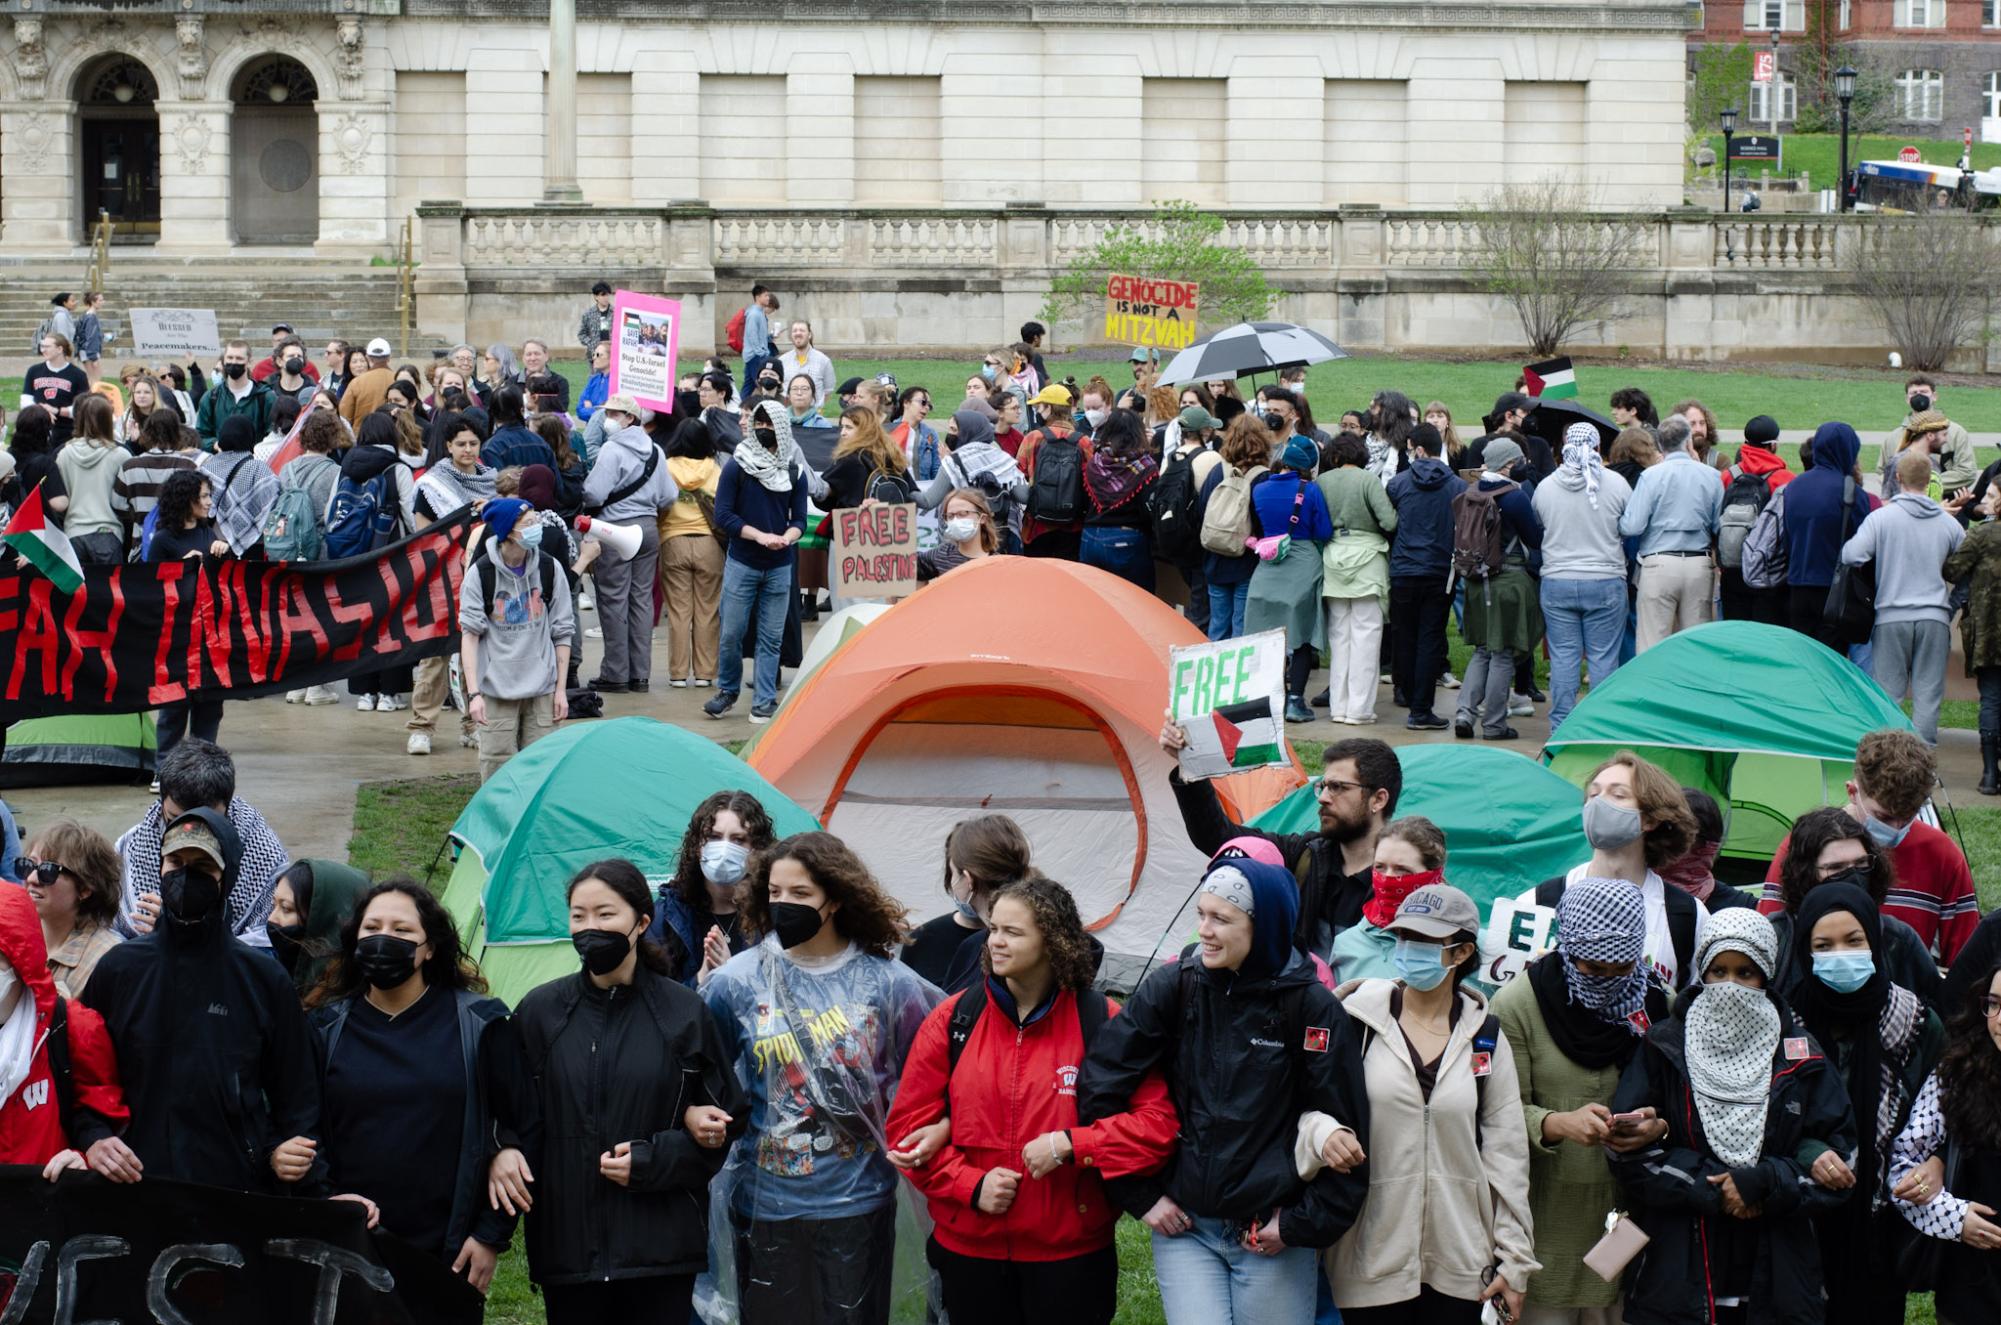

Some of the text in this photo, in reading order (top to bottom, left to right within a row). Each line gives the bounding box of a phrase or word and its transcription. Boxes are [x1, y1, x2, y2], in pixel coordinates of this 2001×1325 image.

[1900, 152, 1919, 162] STOP
[1109, 275, 1198, 310] GENOCIDE
[1116, 301, 1180, 322] IS NOT A
[1105, 313, 1195, 349] MITZVAH
[622, 353, 635, 364] Stop
[841, 506, 910, 547] FREE
[842, 553, 917, 584] PALESTINE
[1171, 646, 1255, 720] FREE
[1257, 1038, 1285, 1048] Columbia
[22, 1078, 49, 1111] W
